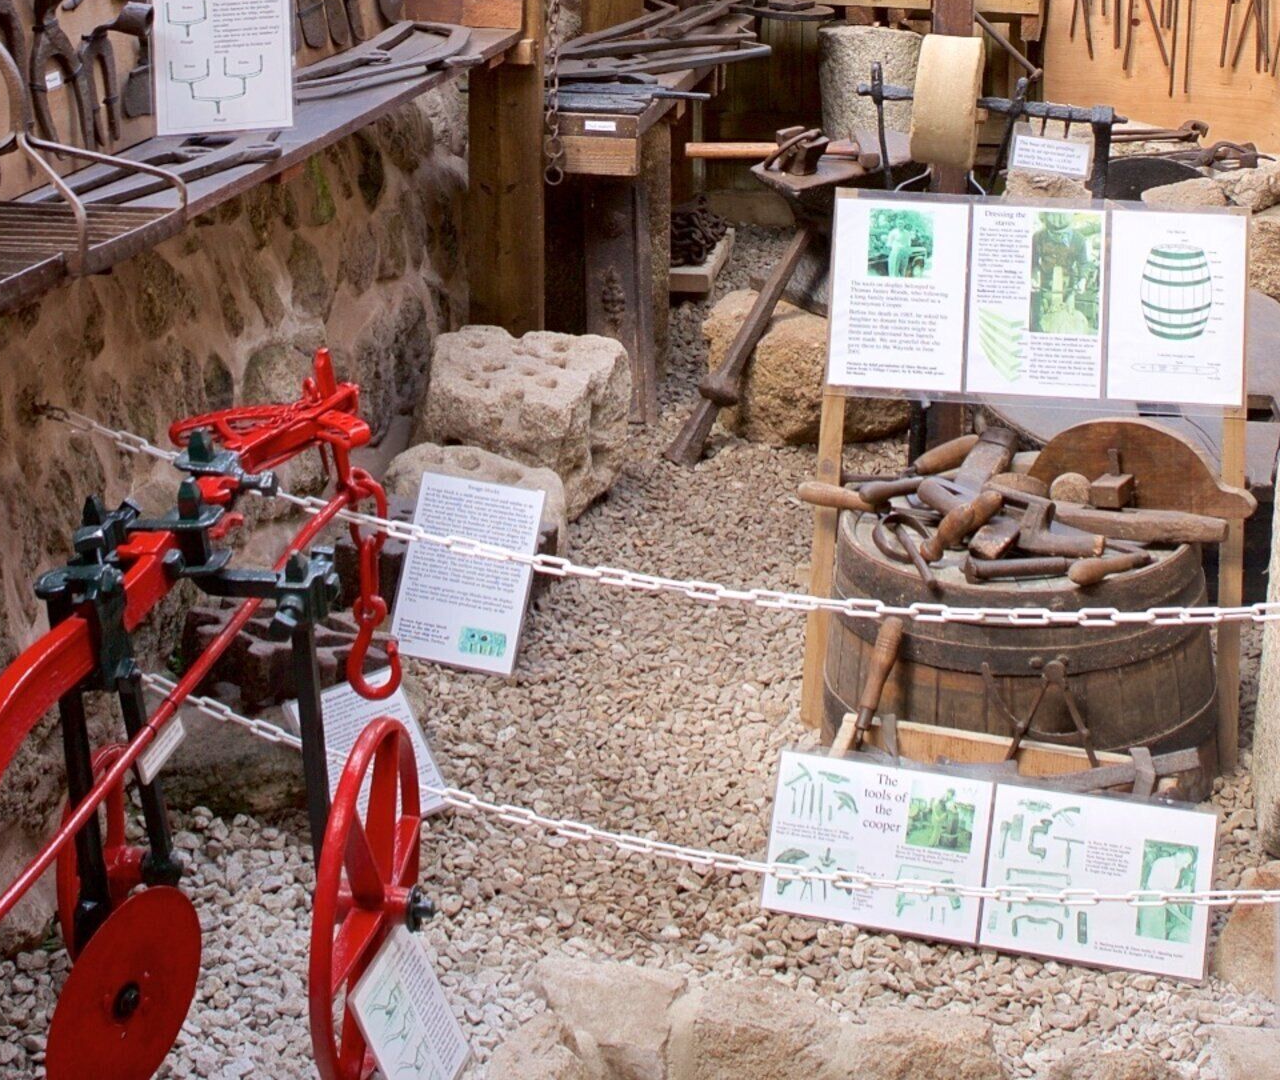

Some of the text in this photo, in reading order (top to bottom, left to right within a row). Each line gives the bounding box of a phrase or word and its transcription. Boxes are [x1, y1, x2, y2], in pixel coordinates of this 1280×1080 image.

[984, 210, 1014, 219] Dressing
[876, 773, 898, 788] The
[864, 788, 909, 804] tools of
[875, 803, 892, 816] the
[862, 819, 901, 833] cooper
